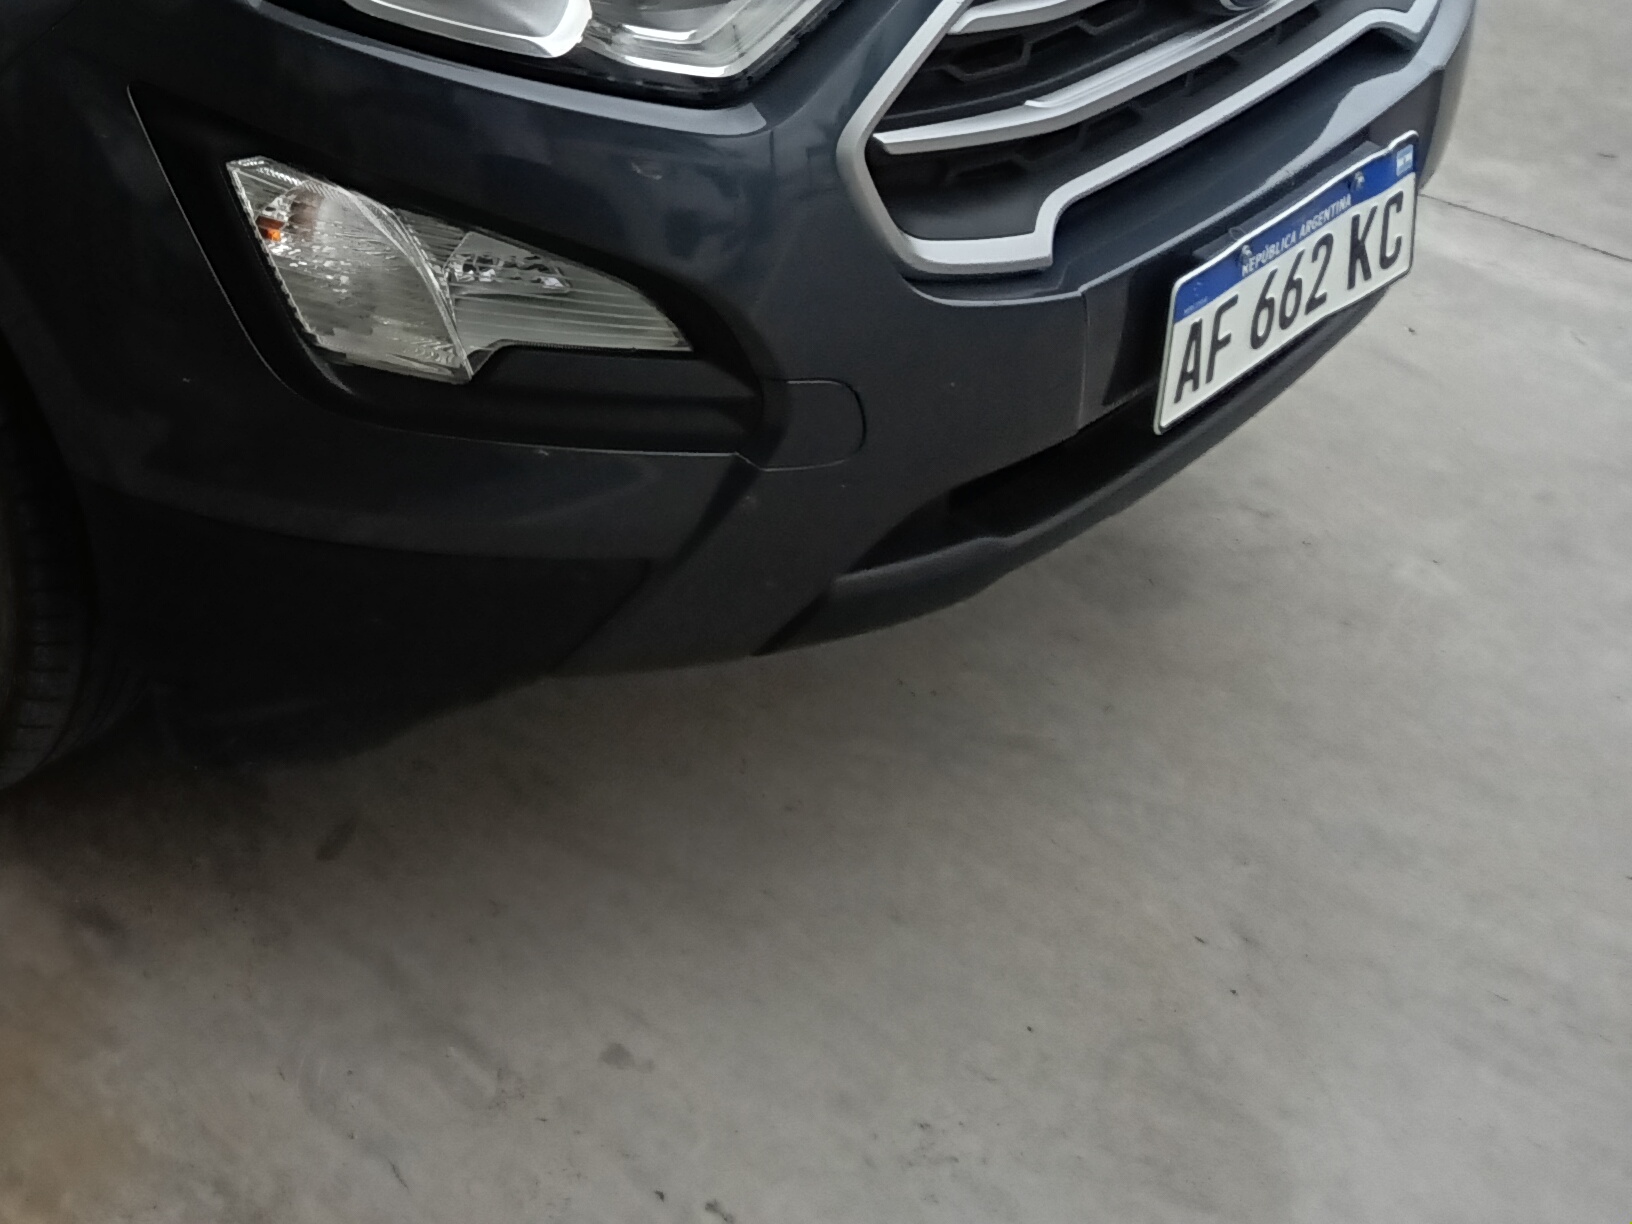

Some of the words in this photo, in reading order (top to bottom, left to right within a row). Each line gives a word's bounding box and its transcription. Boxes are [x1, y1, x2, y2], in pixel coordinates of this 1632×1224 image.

[1299, 193, 1352, 239] ARGENTINA
[1173, 294, 1239, 404] AF
[1250, 232, 1334, 350] 662
[1347, 190, 1404, 291] KC
